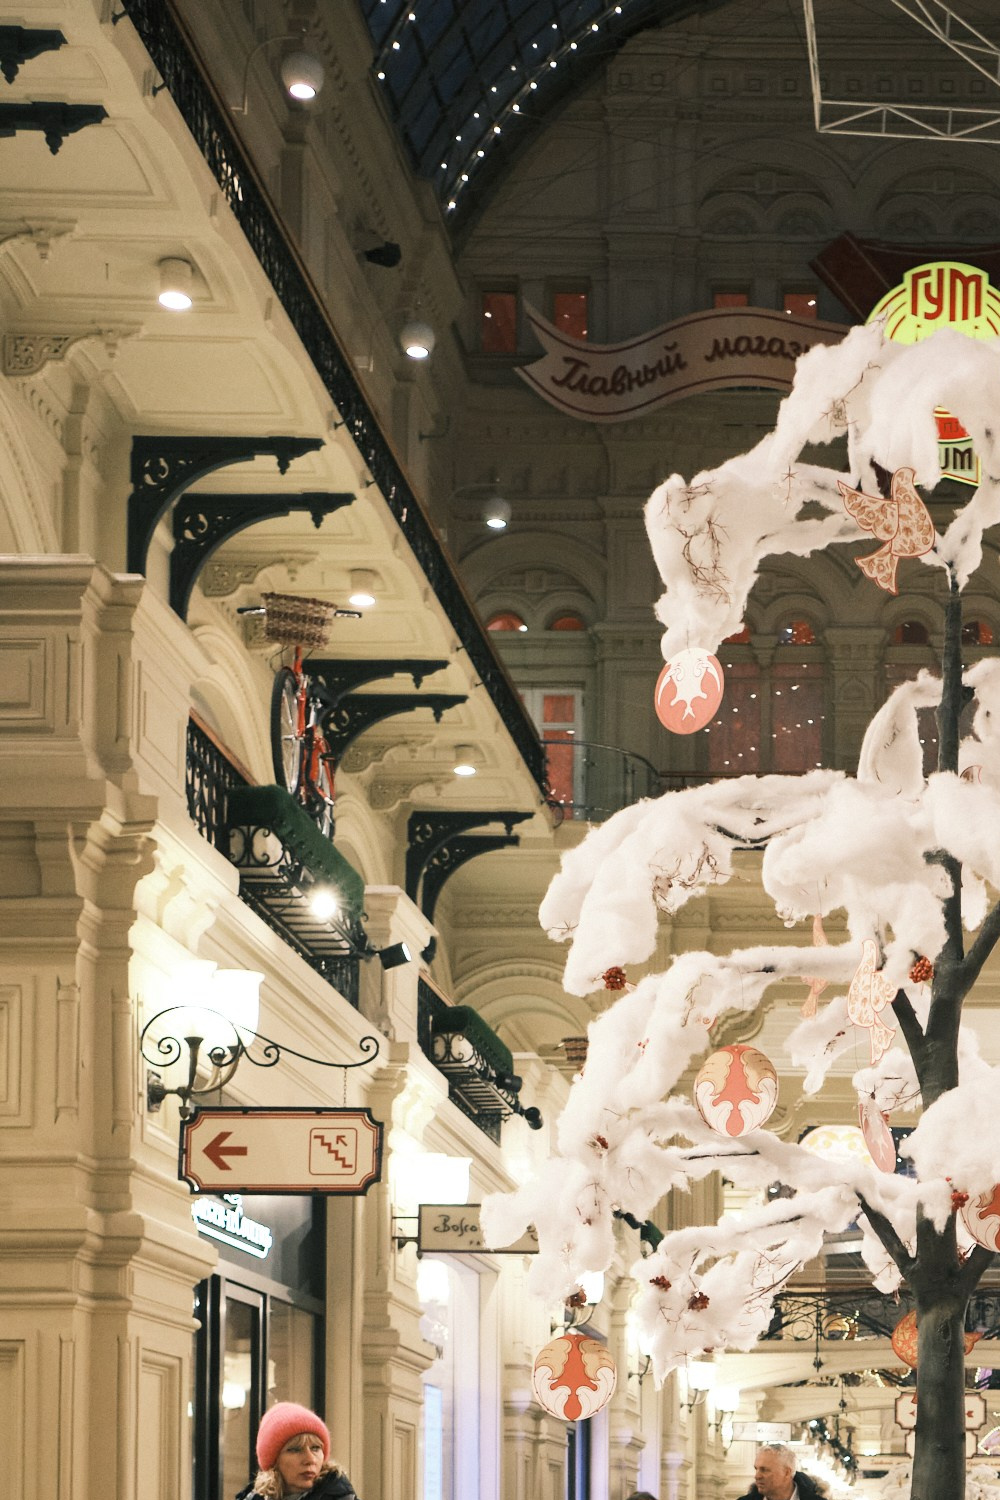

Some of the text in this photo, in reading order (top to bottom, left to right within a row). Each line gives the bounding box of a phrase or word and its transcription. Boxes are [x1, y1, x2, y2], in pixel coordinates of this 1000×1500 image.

[911, 268, 982, 322] ГУМ
[551, 342, 688, 397] Главный
[704, 335, 810, 362] магаз
[433, 1214, 478, 1237] Bosco
